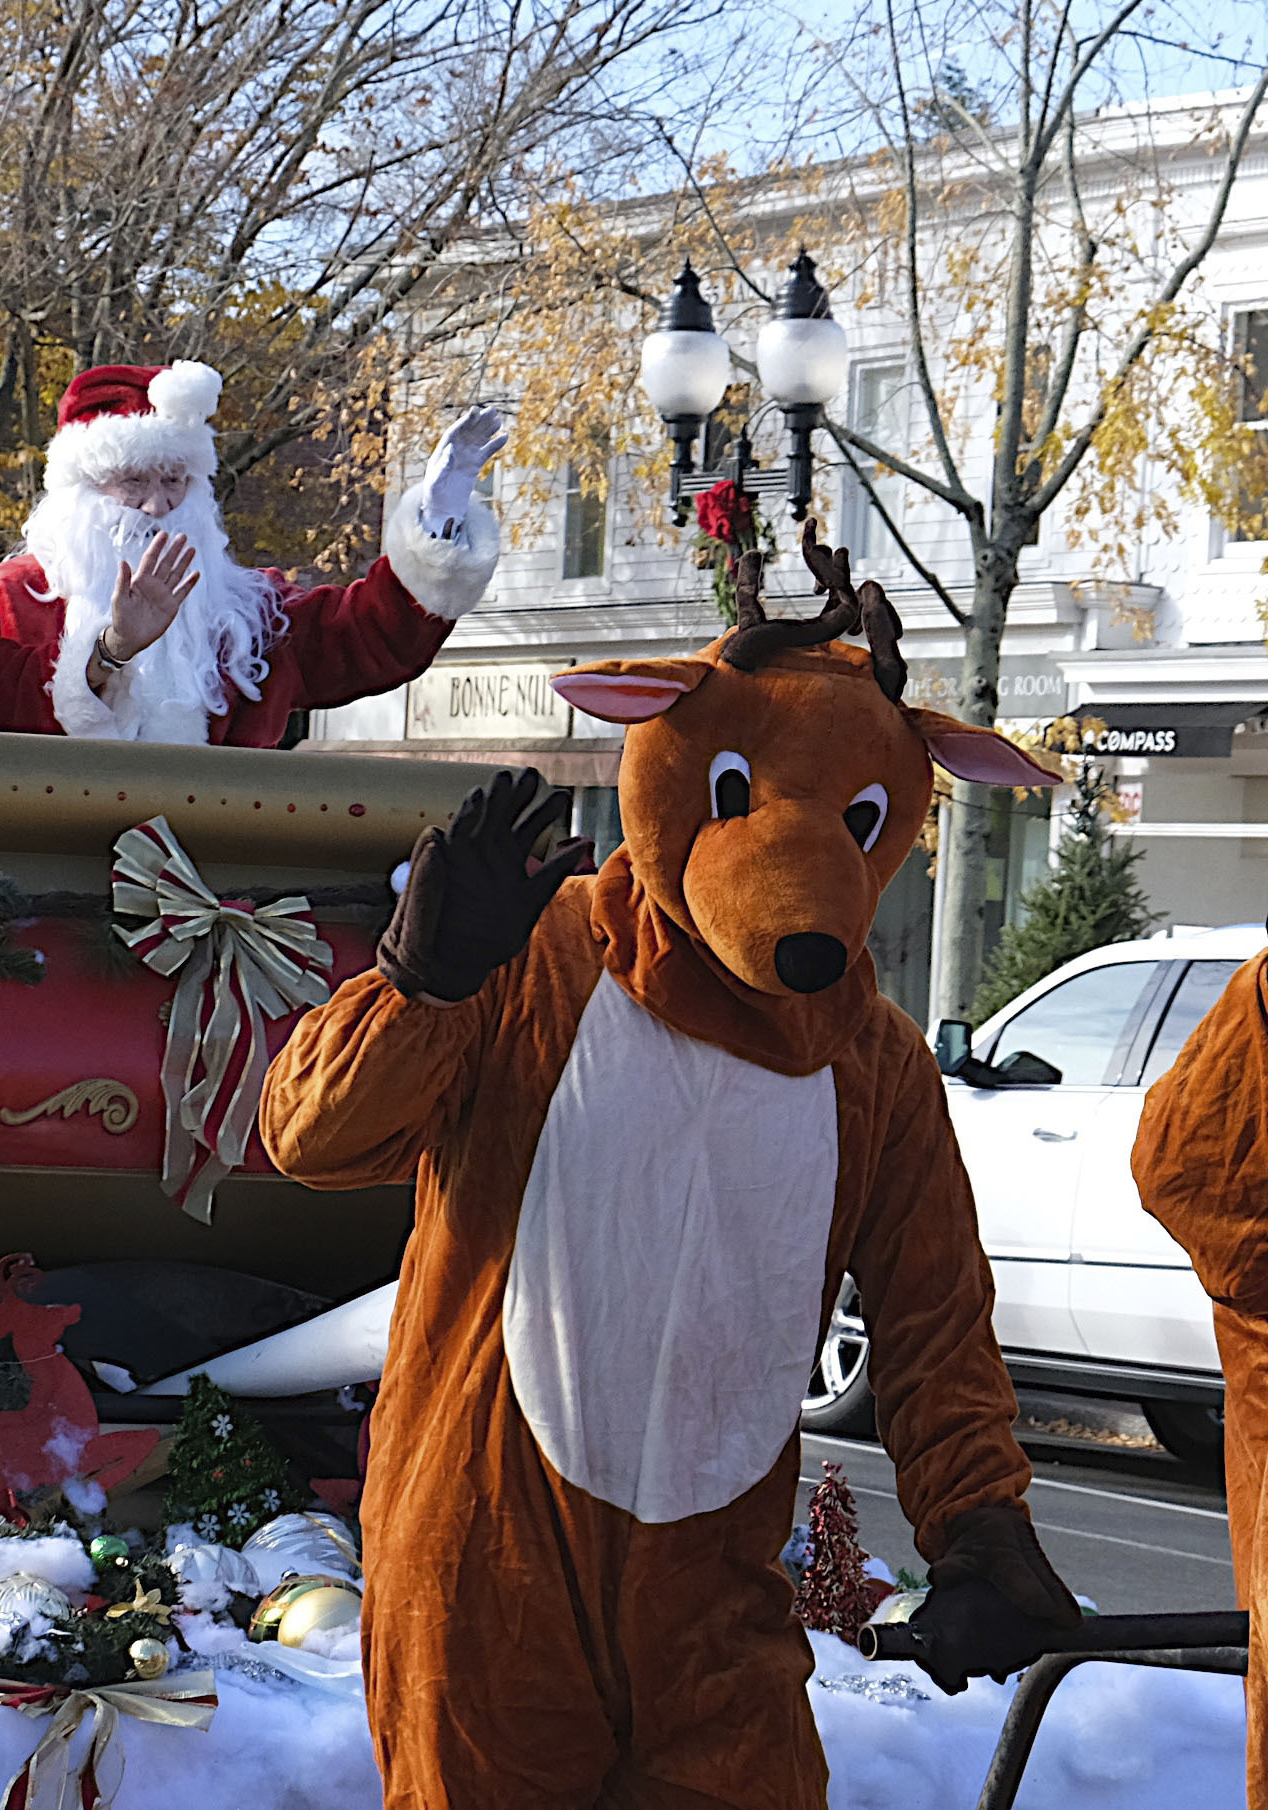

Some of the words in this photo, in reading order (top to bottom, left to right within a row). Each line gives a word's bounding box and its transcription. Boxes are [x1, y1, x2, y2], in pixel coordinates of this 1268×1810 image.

[449, 675, 509, 717] BONNE
[1014, 675, 1062, 696] ROOM
[1096, 730, 1176, 752] COMPASS
